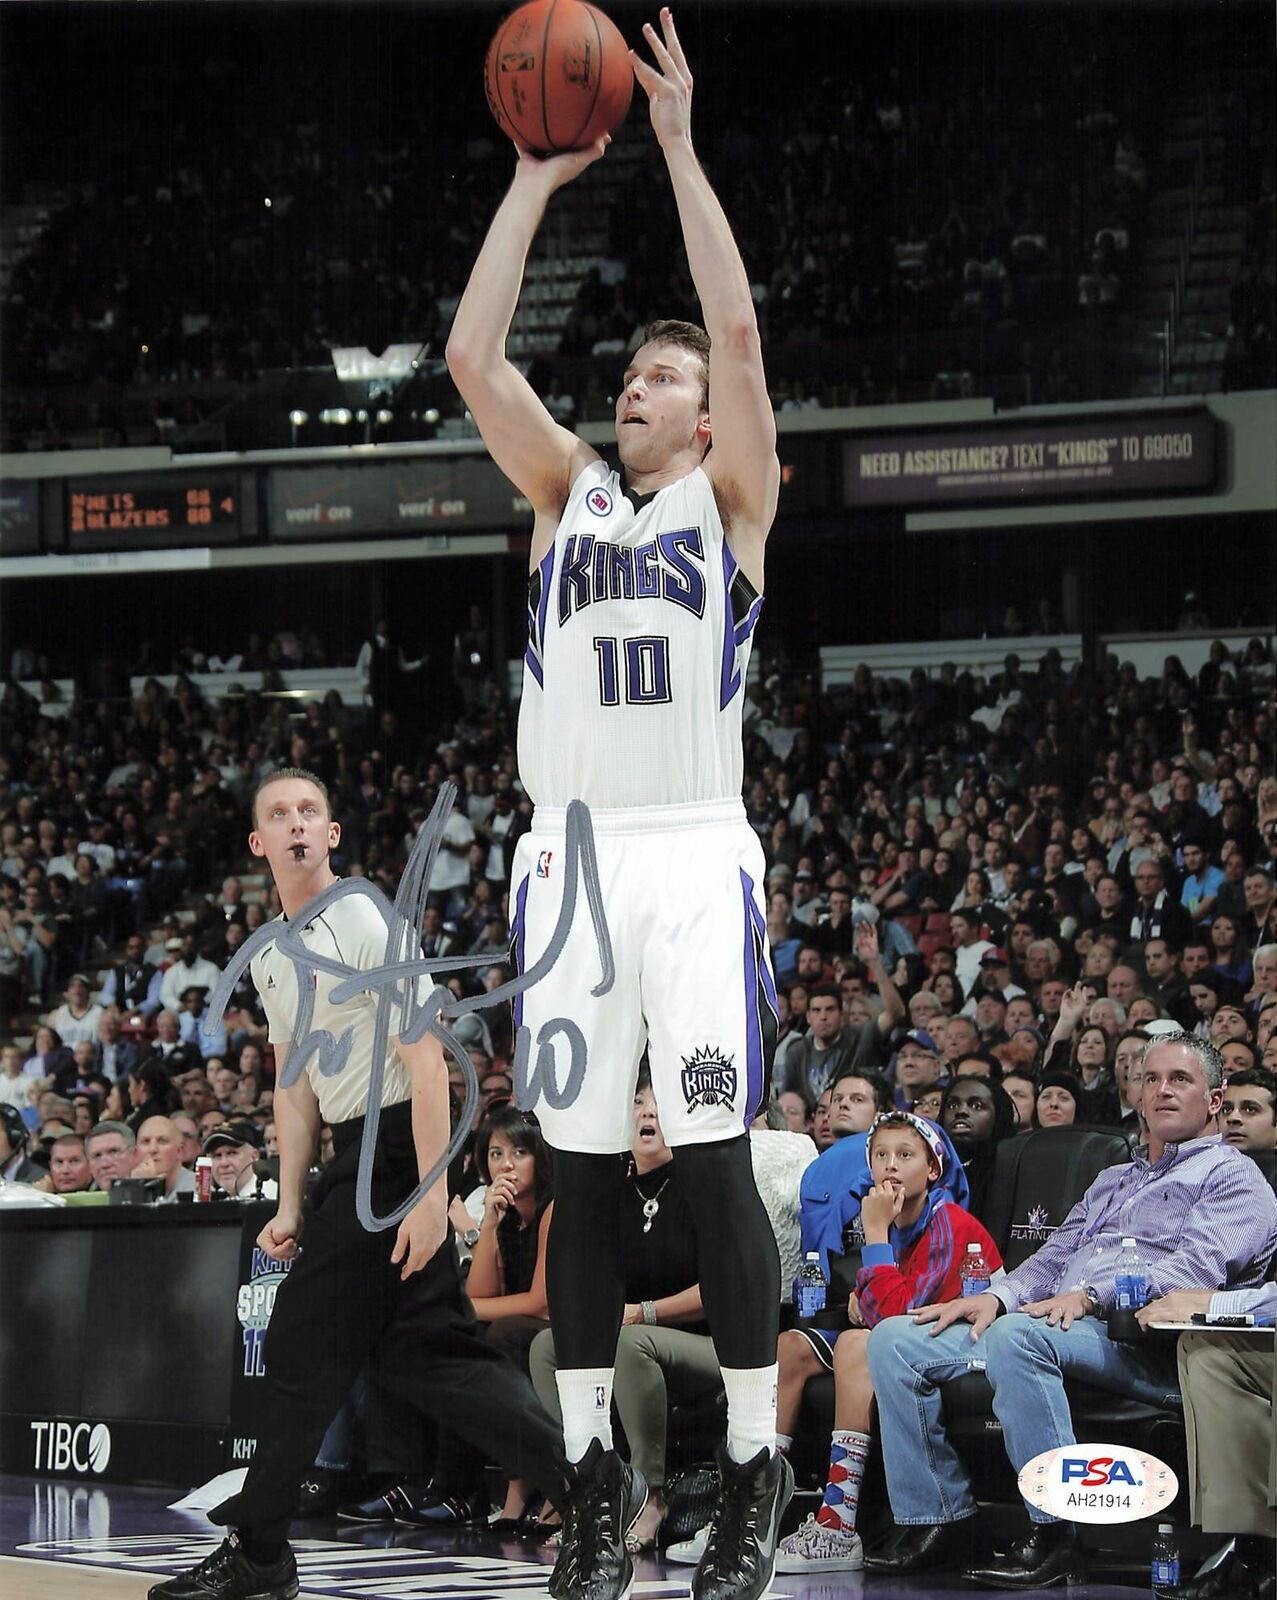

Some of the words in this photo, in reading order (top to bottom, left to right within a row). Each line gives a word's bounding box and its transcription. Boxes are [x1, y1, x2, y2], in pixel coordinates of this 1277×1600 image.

[860, 452, 900, 478] NEED
[903, 445, 1009, 475] ASSISTANCE?
[1012, 442, 1044, 468] TEXT
[1121, 436, 1140, 462] TO
[557, 526, 707, 628] KINGS
[593, 636, 673, 706] 10
[683, 1068, 736, 1102] KINGS
[30, 1421, 111, 1474] TIBCO
